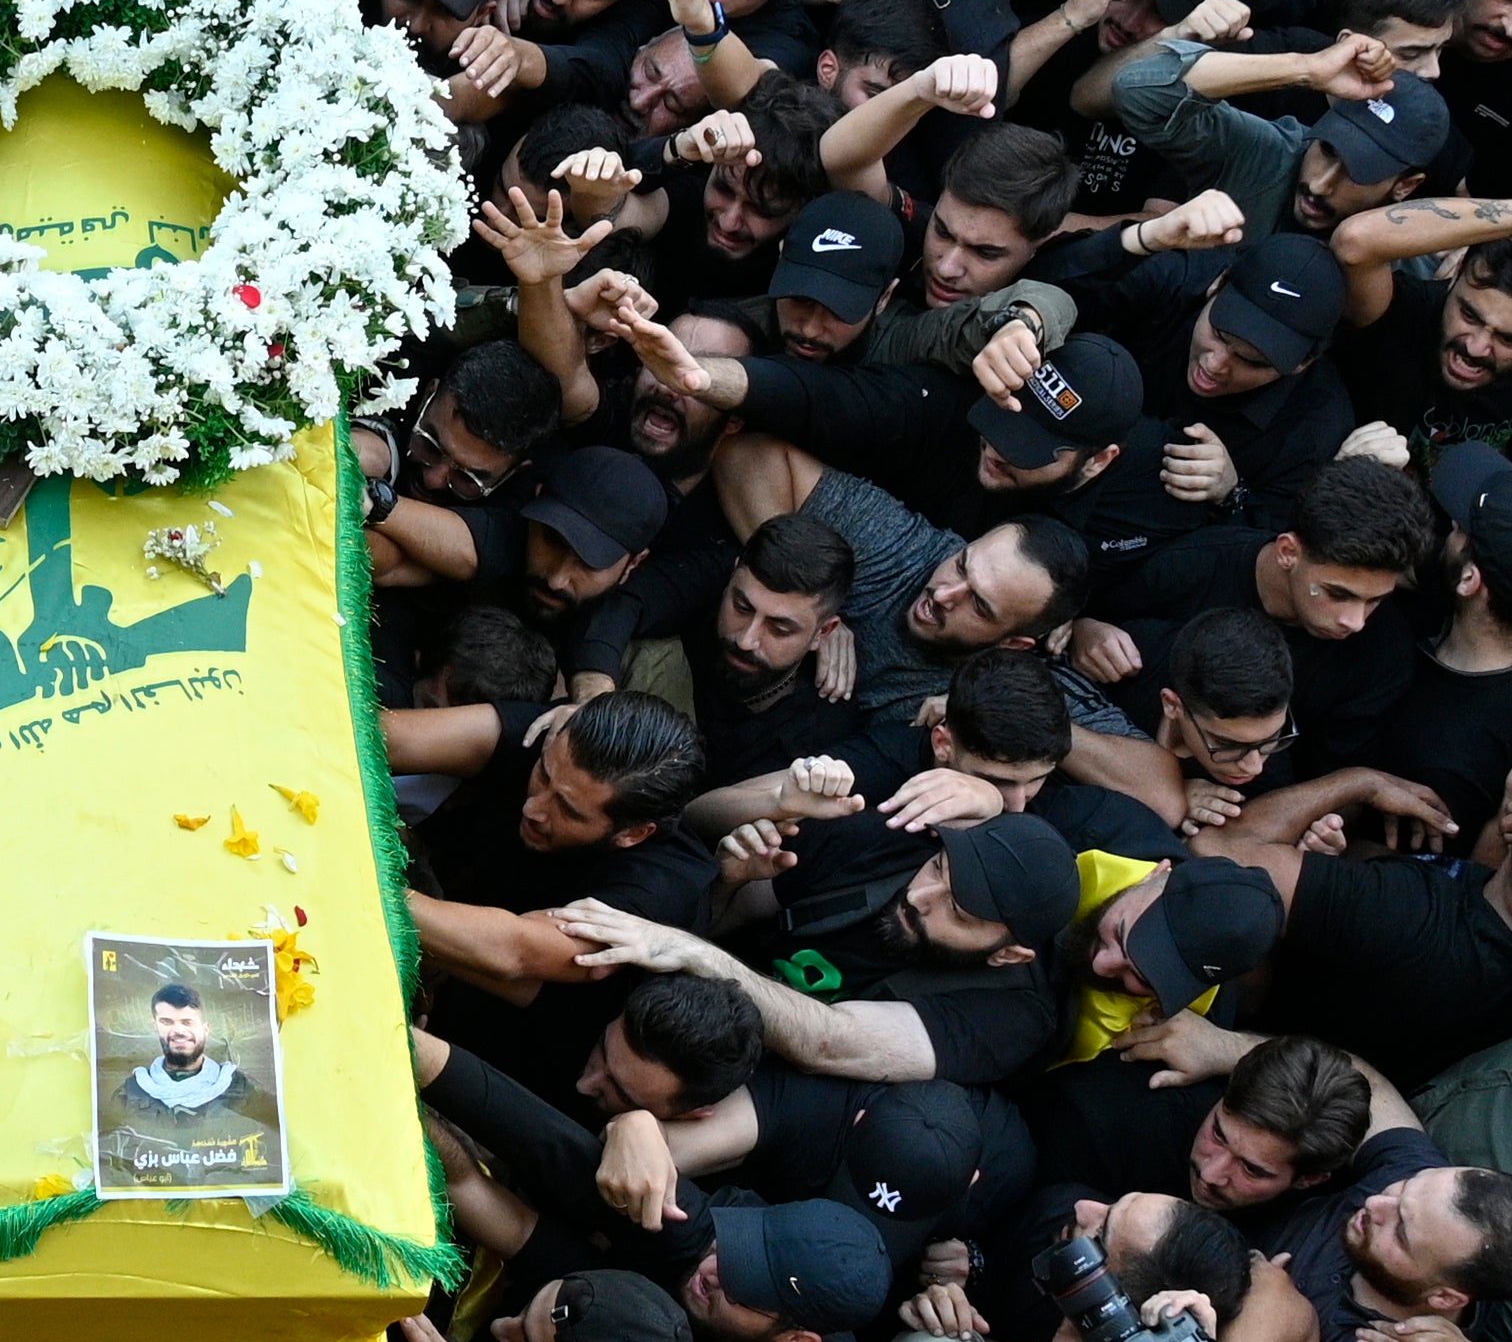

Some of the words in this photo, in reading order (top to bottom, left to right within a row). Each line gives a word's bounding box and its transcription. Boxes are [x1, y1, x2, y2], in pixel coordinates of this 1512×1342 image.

[822, 228, 857, 247] NIKE
[8, 717, 54, 754] الله
[61, 689, 113, 725] هم
[119, 666, 245, 713] الغالبون
[133, 1149, 159, 1171] بزي
[161, 1149, 201, 1169] عباس
[202, 1147, 238, 1167] فضل
